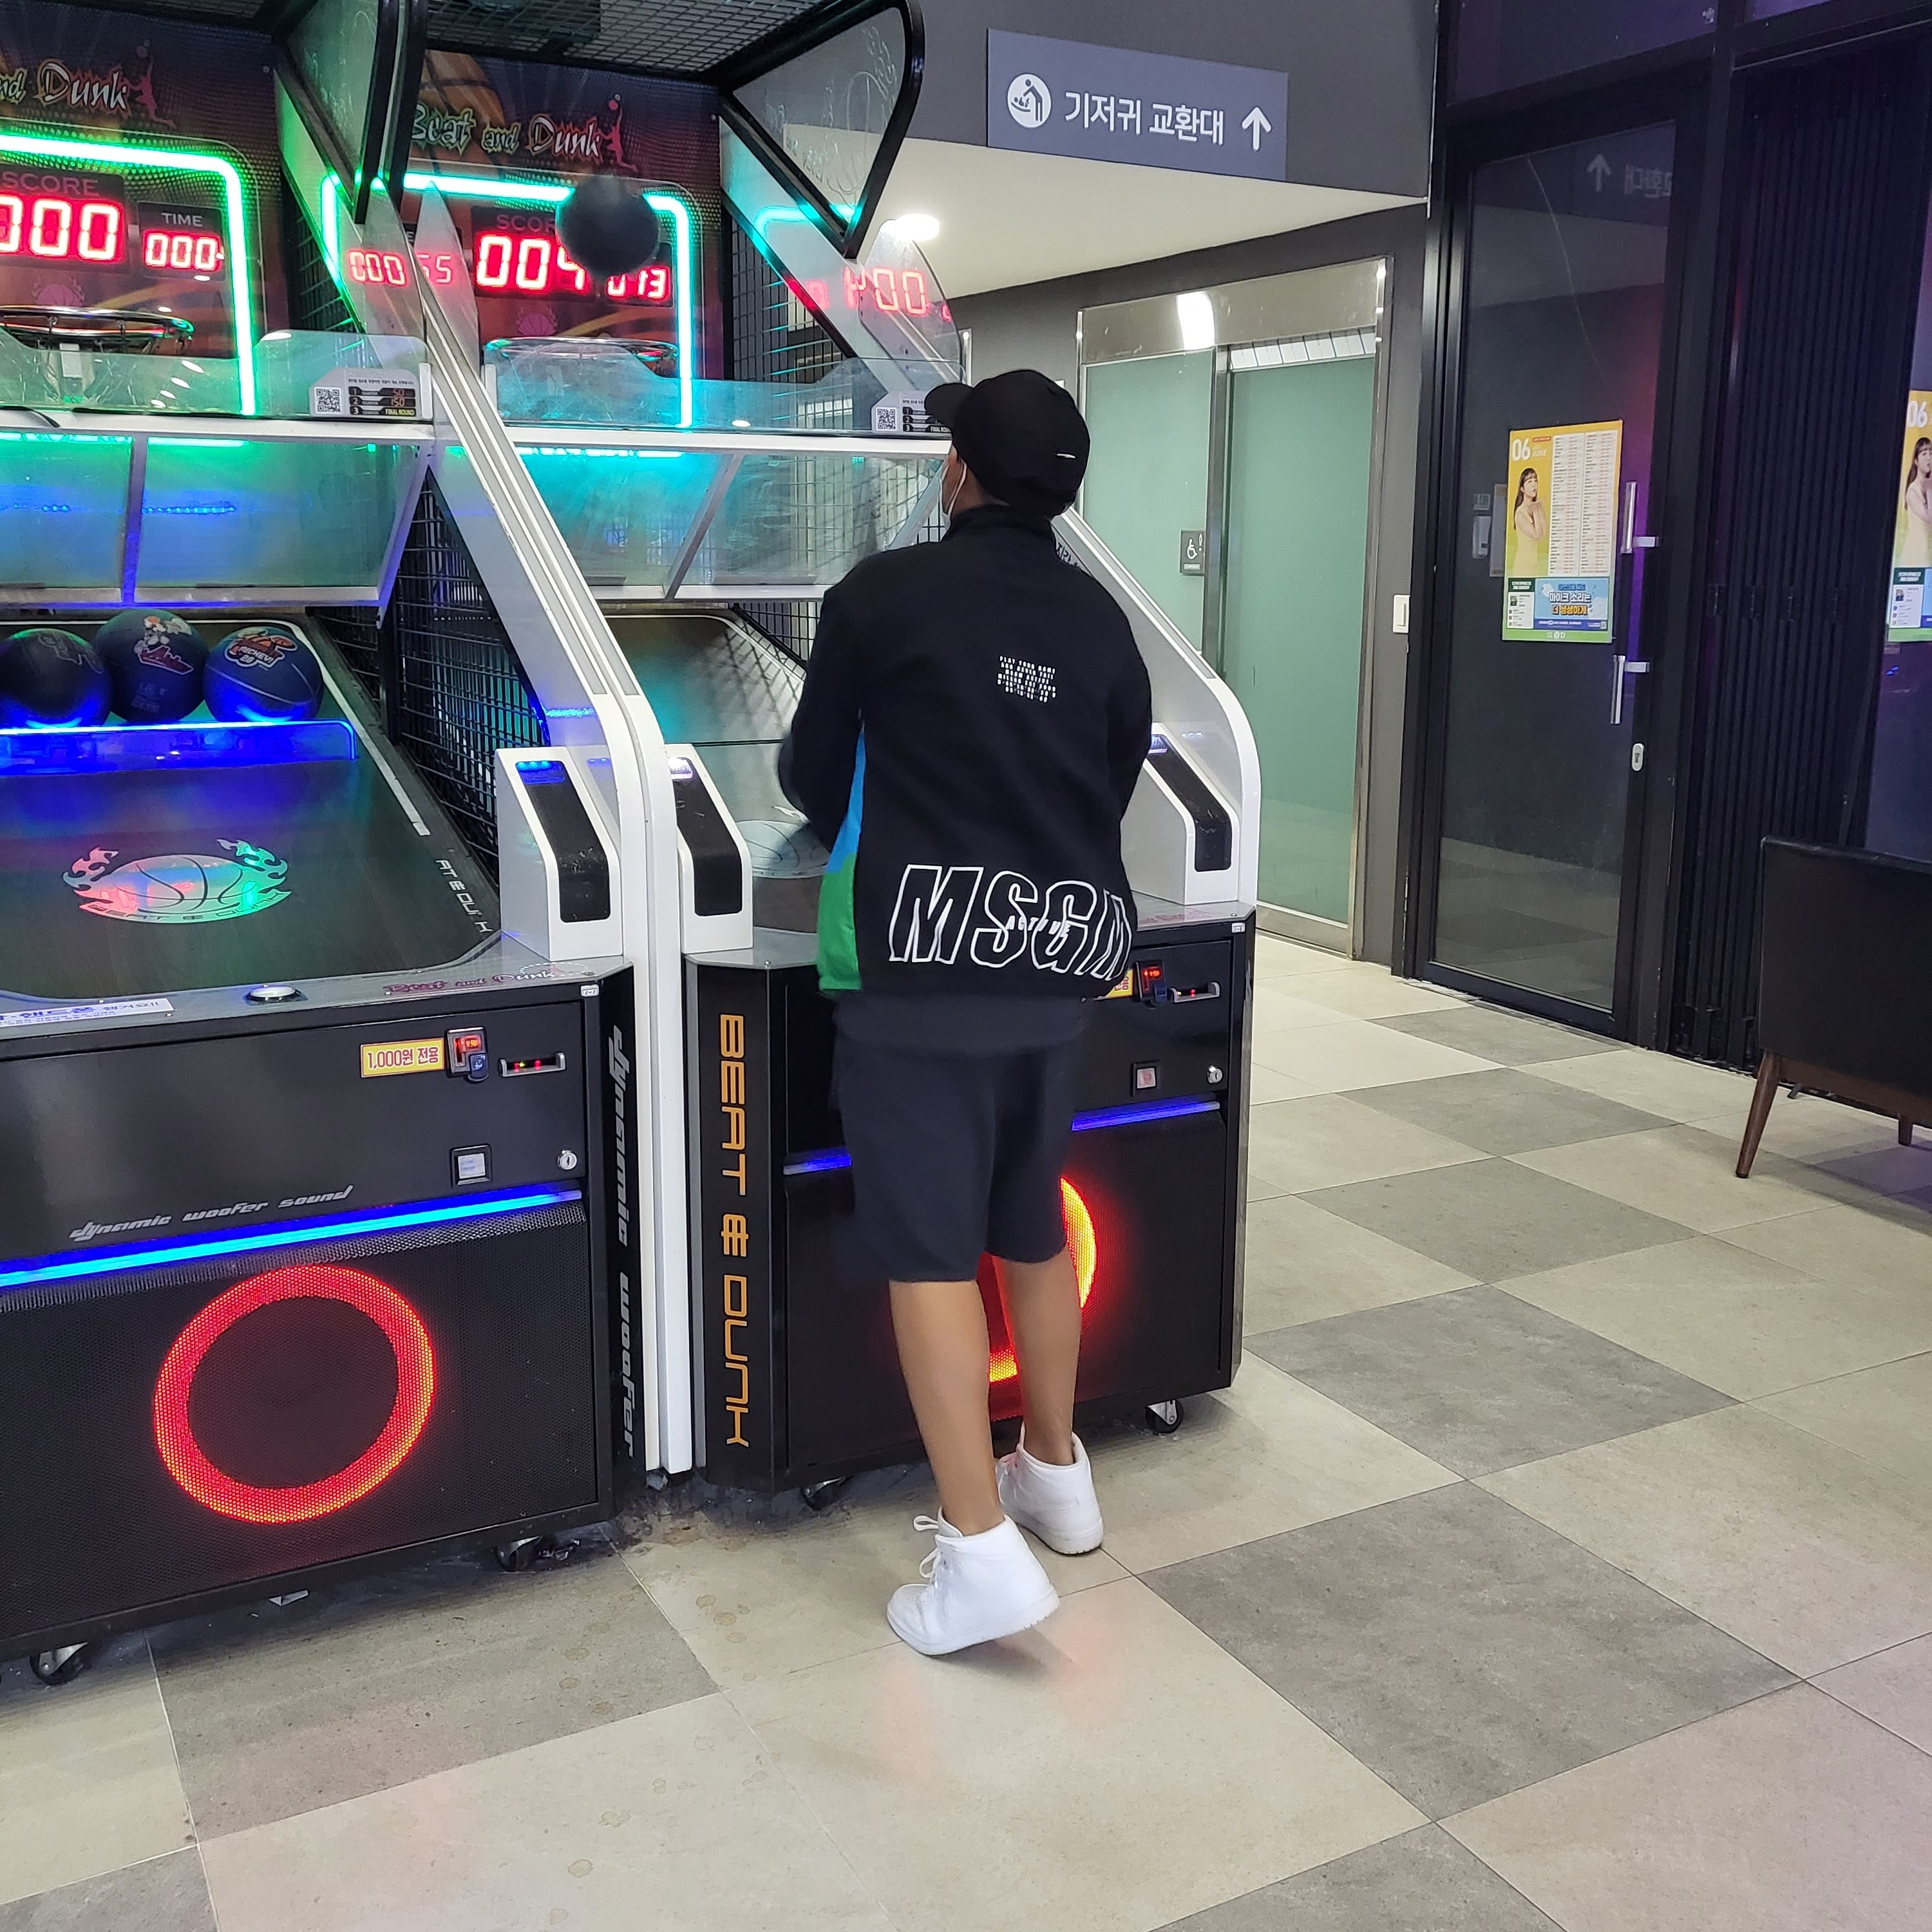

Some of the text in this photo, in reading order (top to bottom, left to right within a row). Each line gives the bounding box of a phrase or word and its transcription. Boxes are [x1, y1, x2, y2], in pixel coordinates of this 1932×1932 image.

[39, 61, 128, 110] Dunk
[1065, 91, 1224, 145] 기저귀 교환대
[531, 115, 600, 158] Dunk
[2, 170, 99, 195] SCORE
[161, 211, 204, 227] TIME
[144, 232, 216, 272] 000
[391, 397, 405, 406] 150
[392, 388, 404, 397] 50
[1907, 400, 1927, 428] 06
[1512, 438, 1531, 461] 06
[1549, 592, 1591, 603] 마이크 소리는
[1552, 605, 1558, 614] 더
[367, 1046, 439, 1069] 1,000원 전용
[719, 1014, 747, 1197] BEAT
[69, 1184, 354, 1242] dynamic woofer sound
[608, 1024, 636, 1459] dynamic woofer
[723, 1274, 750, 1448] DUNK
